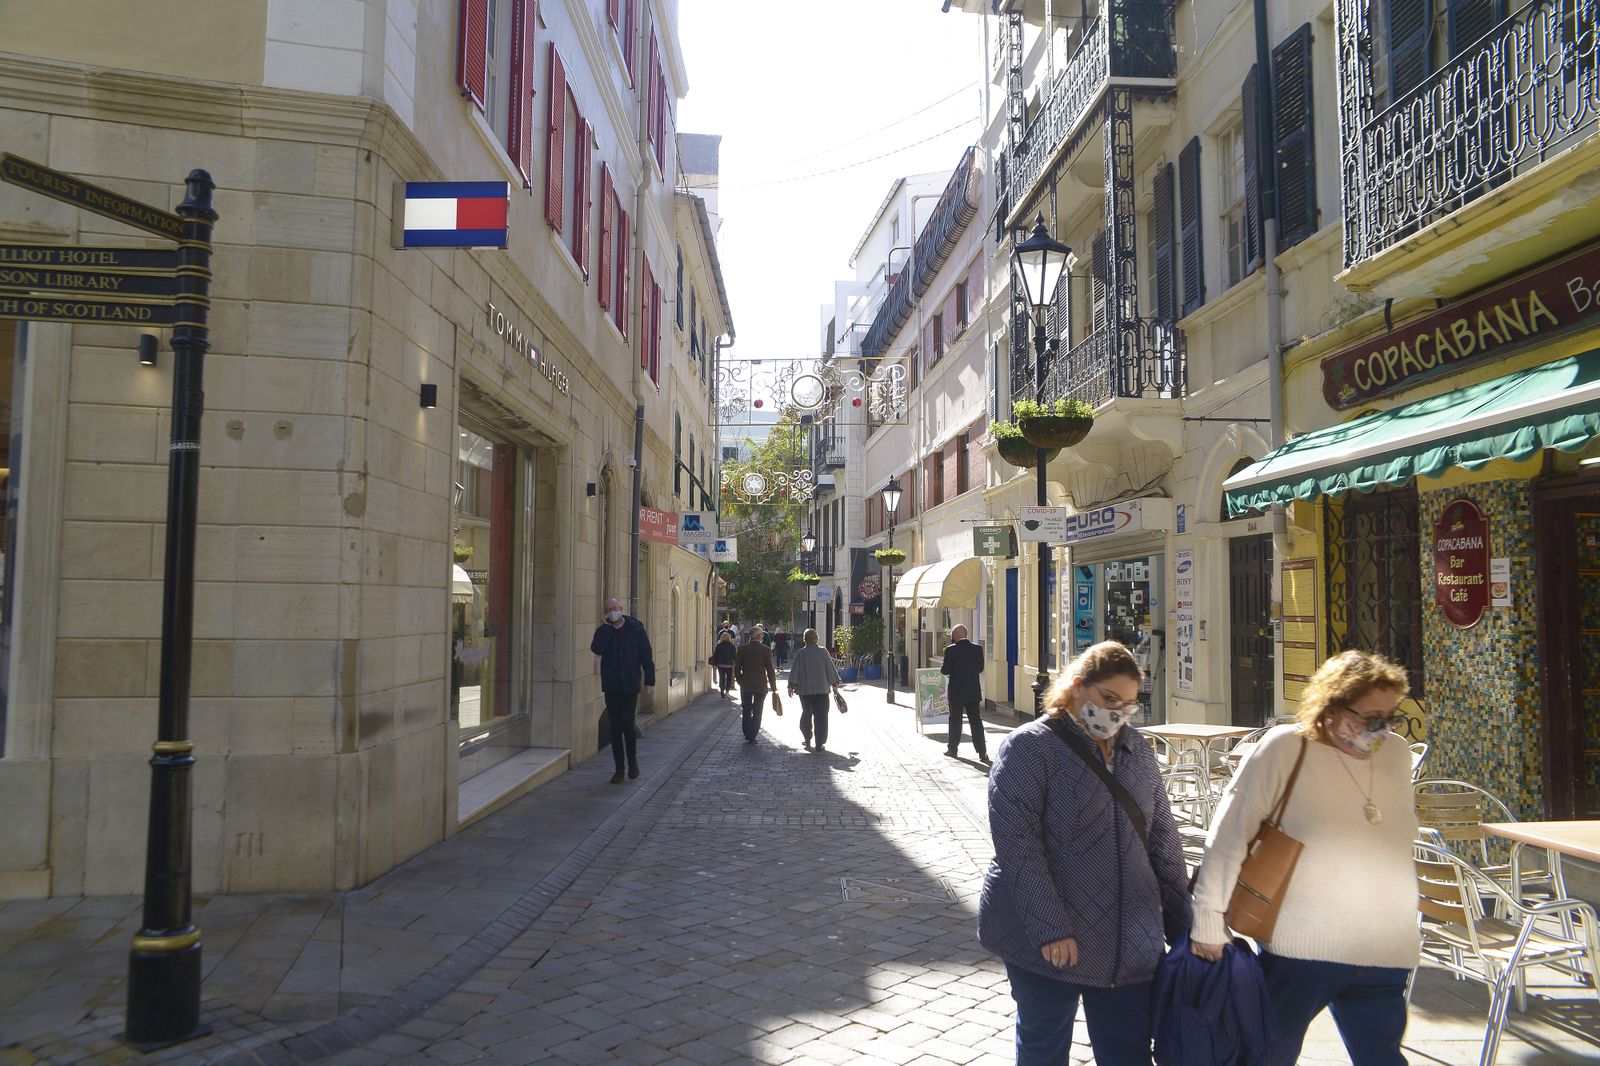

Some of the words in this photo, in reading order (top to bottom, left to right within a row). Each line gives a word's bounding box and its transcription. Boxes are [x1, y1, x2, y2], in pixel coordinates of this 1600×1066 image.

[8, 160, 80, 196] TOURIST
[85, 190, 185, 233] INFORMATION
[0, 248, 55, 262] LLIOT
[59, 250, 119, 264] HOTEL
[45, 272, 125, 290] LIBRARY
[0, 300, 19, 314] H
[23, 301, 48, 314] OF
[52, 302, 152, 320] SCOTLAND
[489, 302, 529, 357] TOMMY
[1353, 289, 1559, 391] COPACABANA
[540, 357, 569, 397] HILFIGER
[646, 510, 664, 525] RENT
[1066, 507, 1115, 541] EURO
[1437, 536, 1483, 552] COPACABANA
[1450, 555, 1465, 568] Bar
[1438, 572, 1485, 585] Restaurant
[1450, 588, 1468, 602] Café
